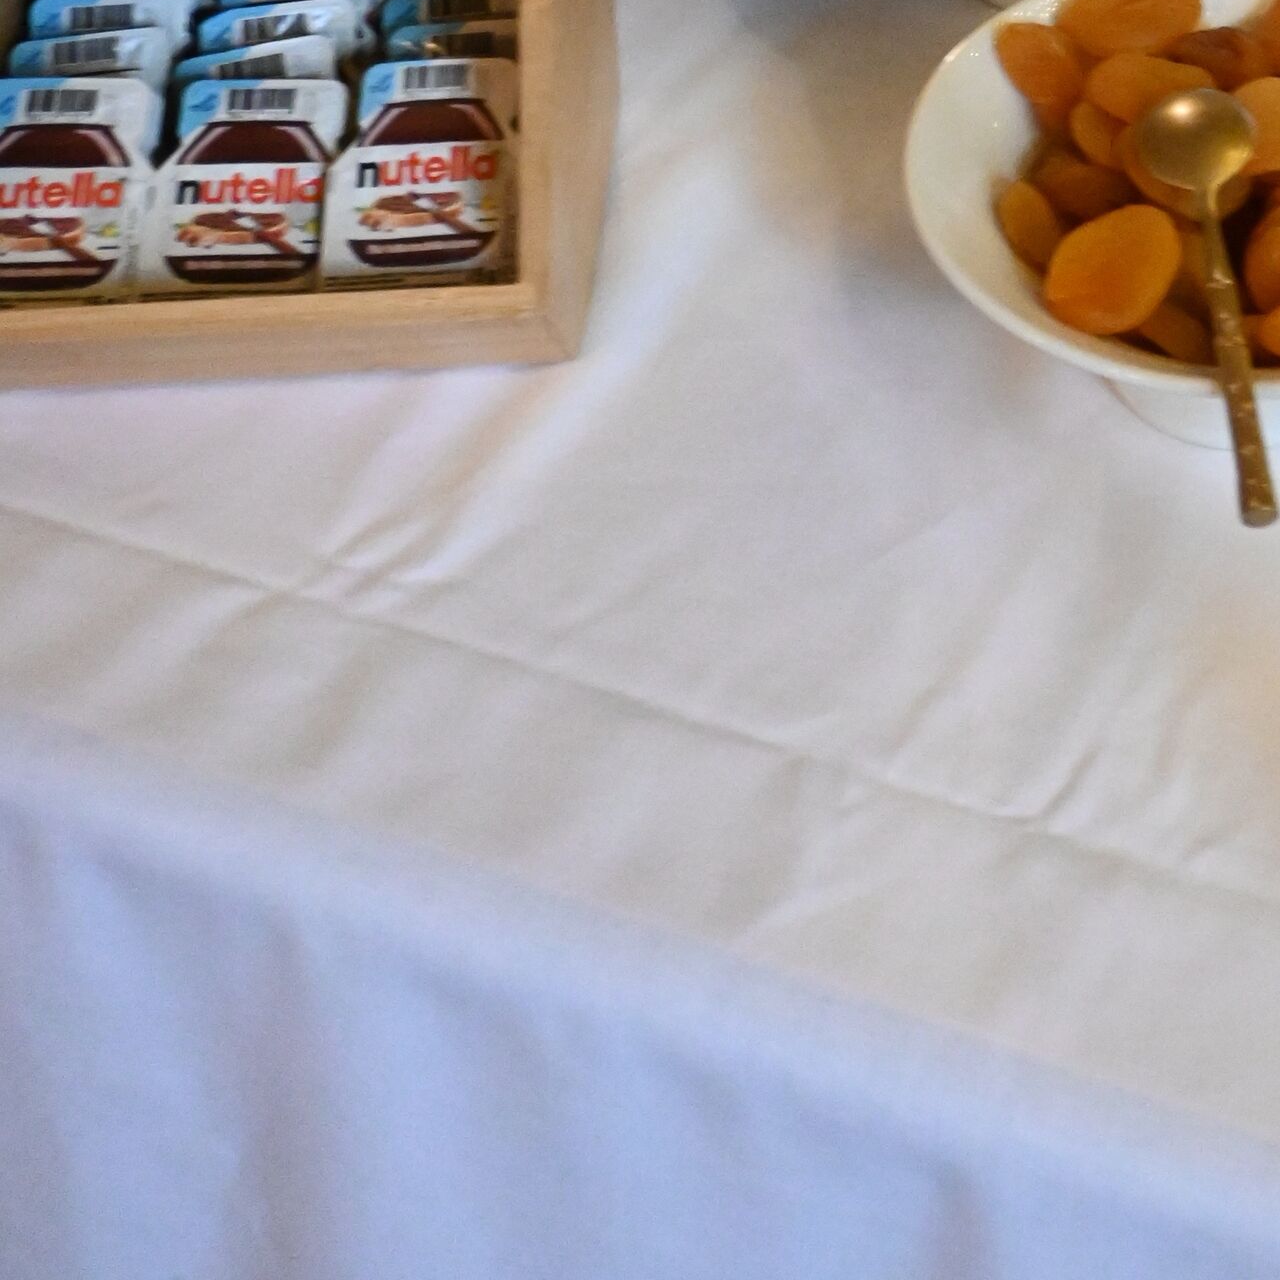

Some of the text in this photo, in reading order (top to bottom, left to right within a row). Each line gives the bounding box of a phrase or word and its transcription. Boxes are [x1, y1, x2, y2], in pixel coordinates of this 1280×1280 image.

[357, 145, 497, 188] nutella
[0, 171, 124, 208] utella
[176, 168, 323, 205] nutella
